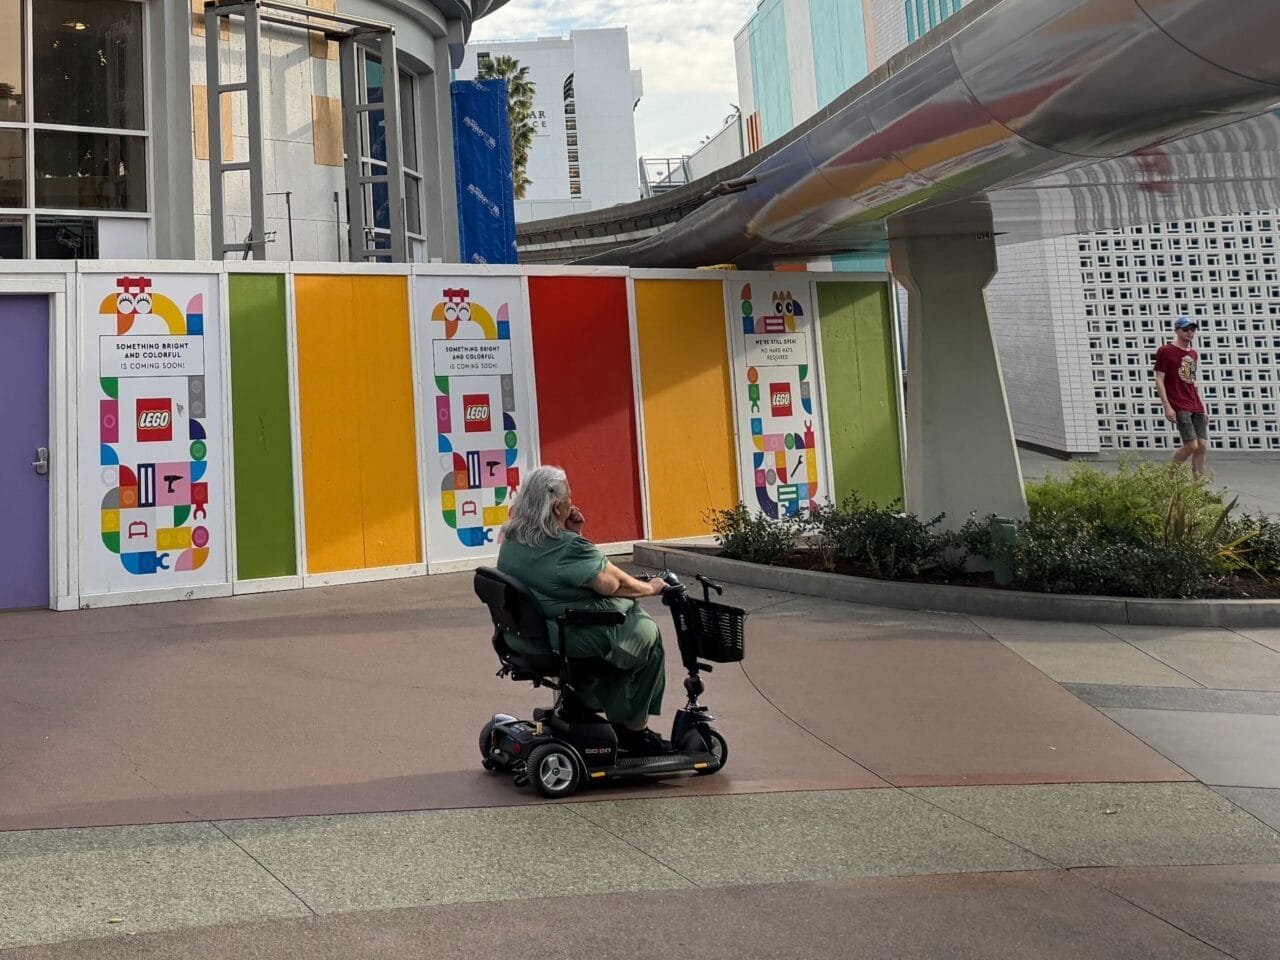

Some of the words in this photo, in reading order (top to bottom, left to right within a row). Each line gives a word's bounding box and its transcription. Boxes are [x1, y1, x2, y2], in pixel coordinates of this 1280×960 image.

[162, 342, 189, 350] BRIGHT
[142, 351, 181, 359] COLORFUL
[120, 362, 128, 370] IS
[129, 362, 160, 370] COMING
[162, 361, 186, 369] SOON!
[773, 393, 790, 406] LEGO
[466, 406, 488, 420] LEGO
[139, 411, 169, 428] LEGO
